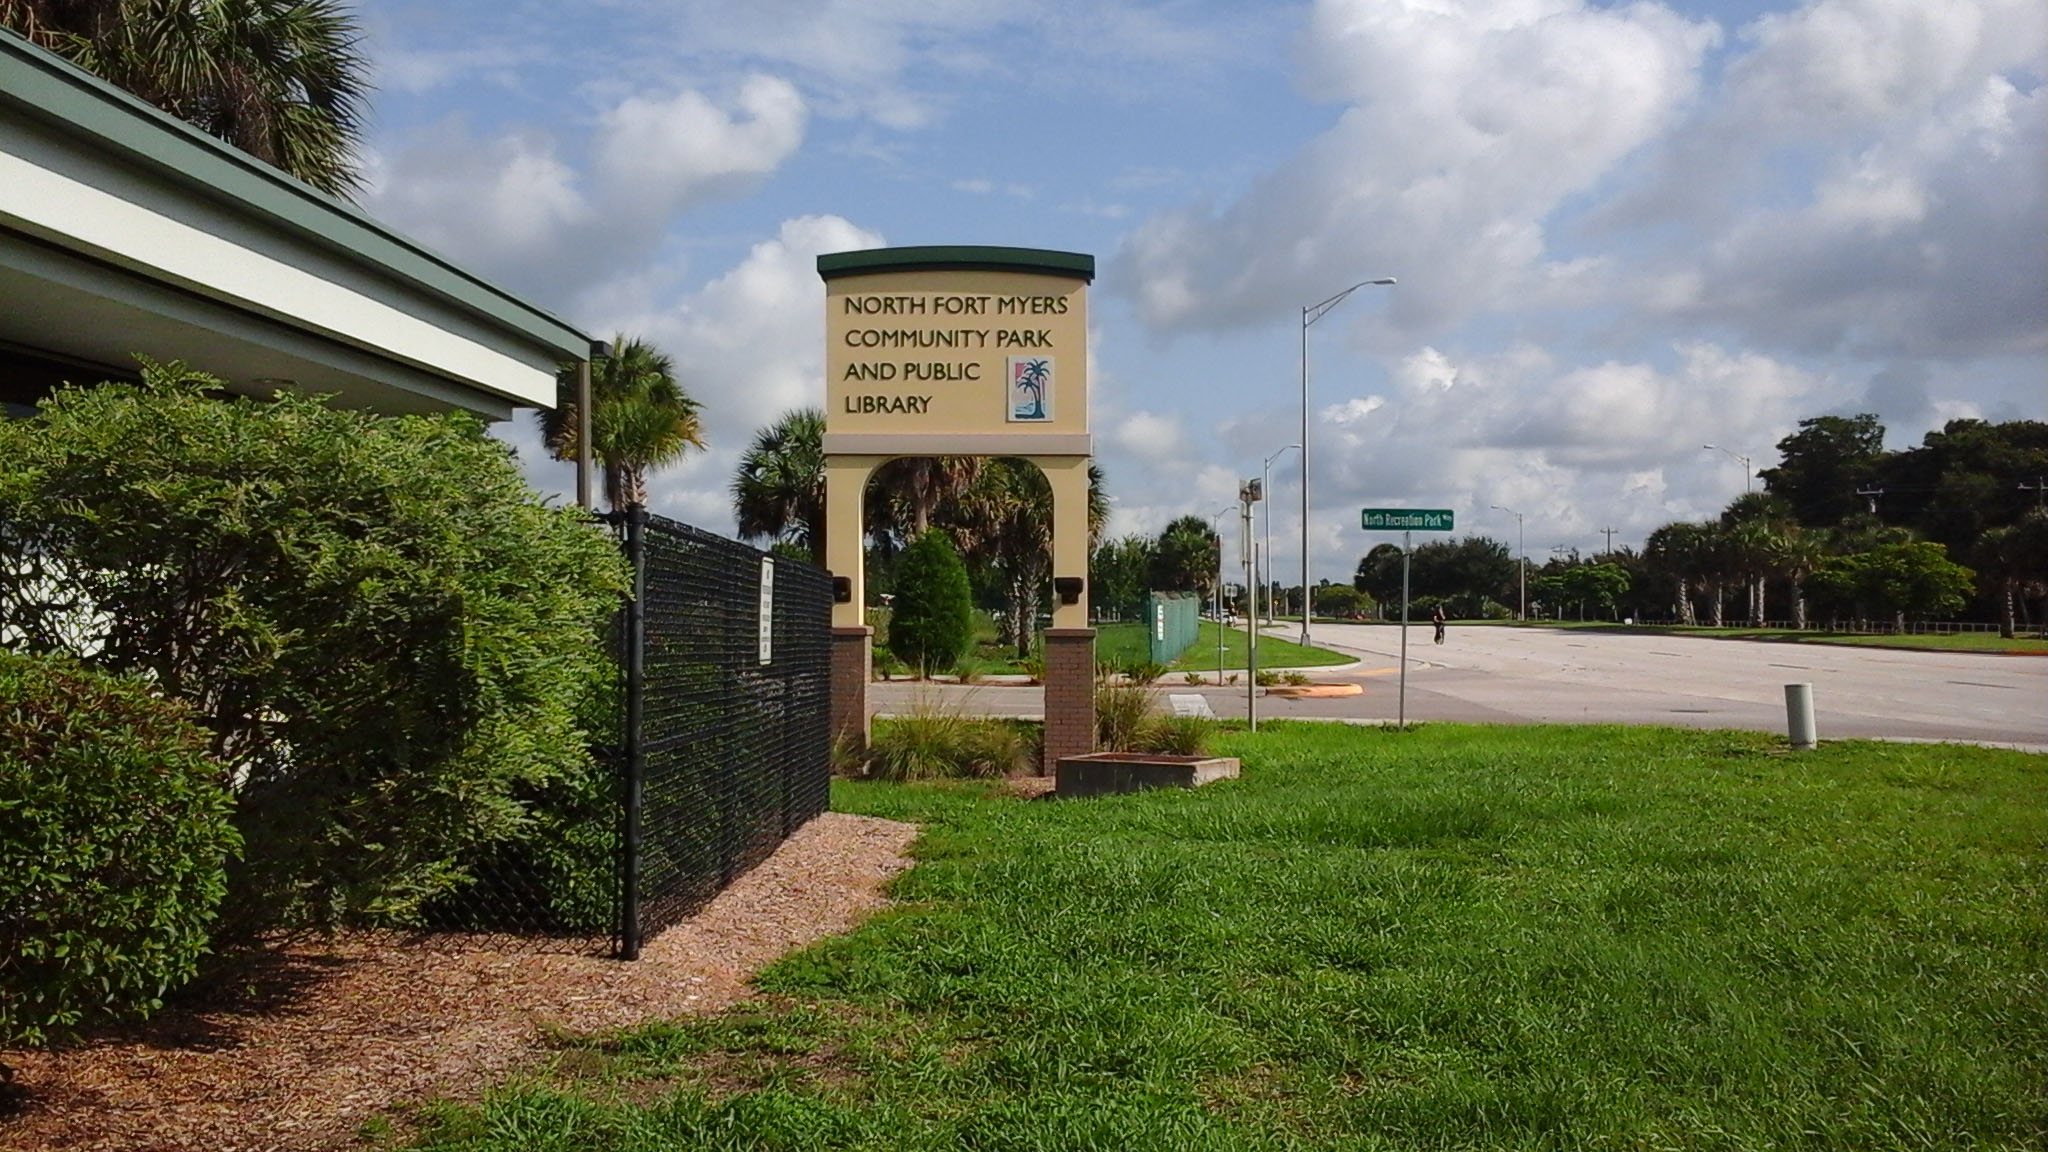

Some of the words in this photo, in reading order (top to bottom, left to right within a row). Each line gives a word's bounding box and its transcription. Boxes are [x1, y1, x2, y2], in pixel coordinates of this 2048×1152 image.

[845, 296, 926, 315] NORTH
[933, 296, 991, 315] FORT
[997, 296, 1069, 315] MYERS
[845, 329, 990, 348] COMMUNITY
[996, 329, 1053, 348] PARK
[844, 362, 896, 381] AND
[903, 362, 981, 381] PUBLIC
[845, 395, 932, 414] LIBRARY
[1363, 513, 1383, 526] North
[1385, 513, 1423, 527] Recreation
[1424, 513, 1442, 527] Park
